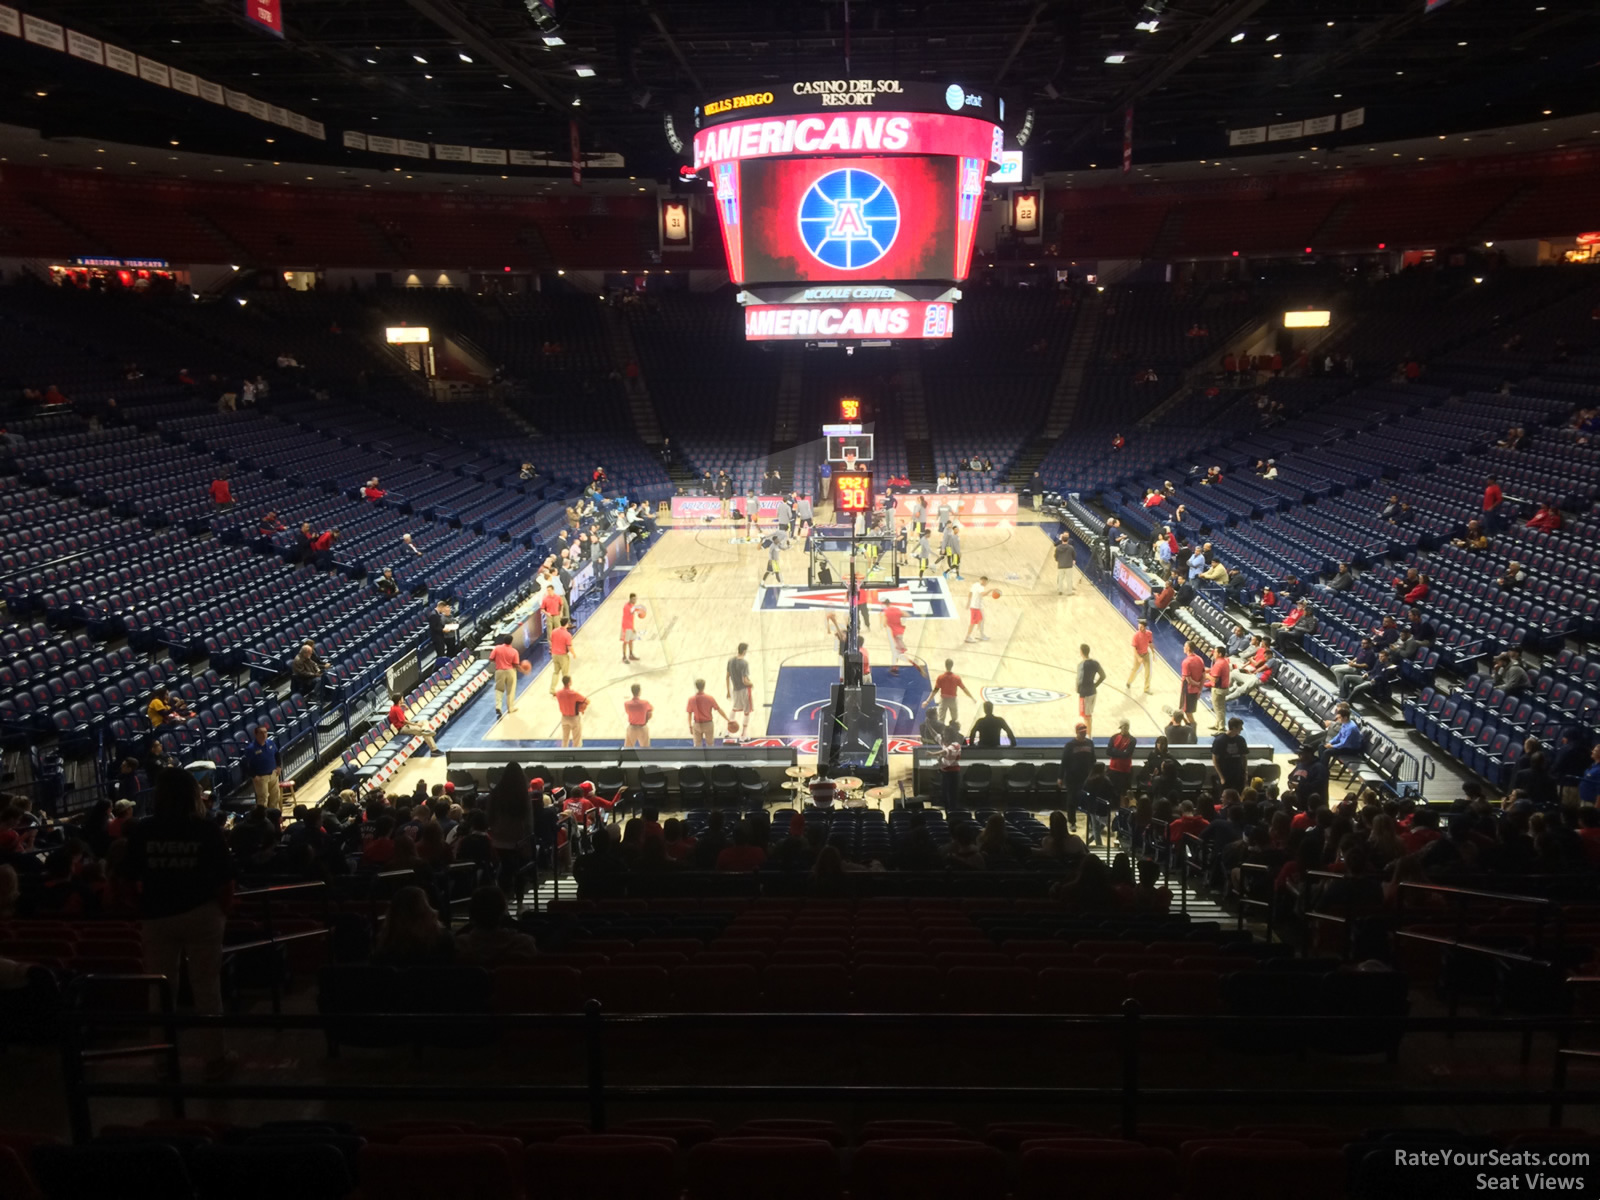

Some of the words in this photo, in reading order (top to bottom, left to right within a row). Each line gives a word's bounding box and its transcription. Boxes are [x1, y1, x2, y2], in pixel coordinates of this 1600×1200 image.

[793, 79, 848, 95] CASINO
[849, 79, 876, 93] DEL
[876, 80, 904, 93] SOL
[704, 98, 732, 116] WELLS
[732, 92, 774, 109] FARGO
[821, 92, 876, 106] RESORT
[1020, 209, 1032, 219] 22
[671, 218, 681, 228] 31
[852, 287, 897, 300] CENTER
[922, 304, 948, 338] 28
[843, 407, 857, 418] 30
[842, 489, 866, 509] 30
[393, 655, 418, 679] NETWORKS
[146, 840, 202, 854] EVENT
[149, 856, 199, 869] STAFF
